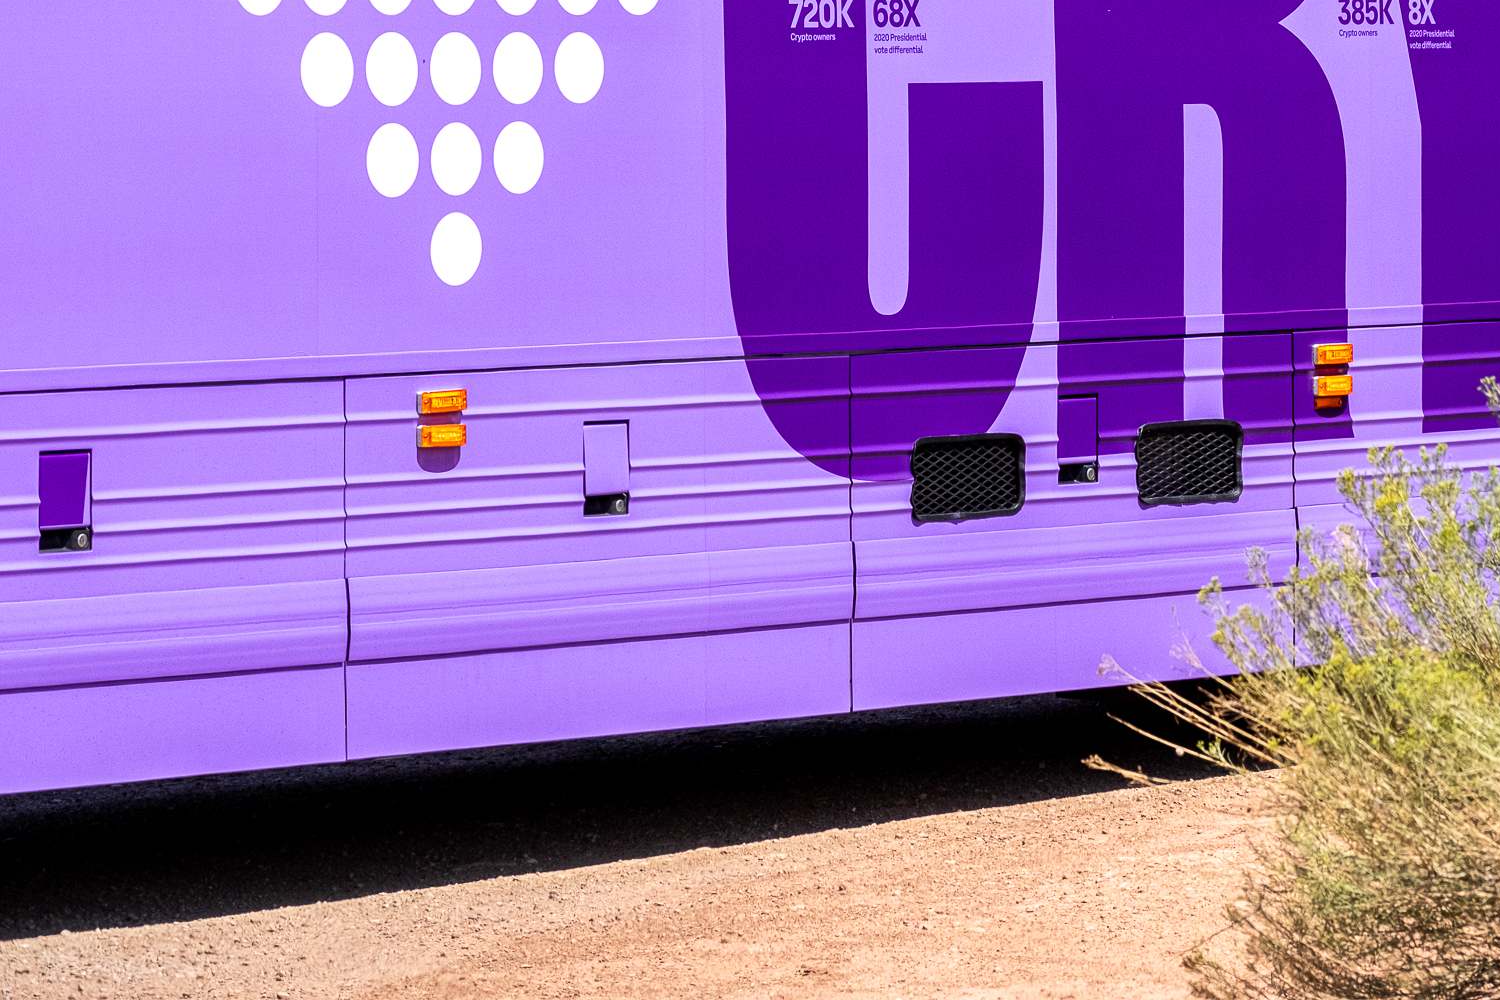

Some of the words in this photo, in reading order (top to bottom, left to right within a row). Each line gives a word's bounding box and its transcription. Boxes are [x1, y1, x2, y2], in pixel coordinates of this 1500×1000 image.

[790, 32, 813, 43] Crypto
[873, 33, 890, 42] 2020
[890, 32, 928, 42] Presidential
[1338, 28, 1358, 38] Crypto
[1409, 29, 1423, 38] 2020
[1423, 29, 1456, 38] Presidential
[873, 46, 888, 54] vote
[888, 45, 924, 54] differential
[1409, 42, 1422, 50] vote
